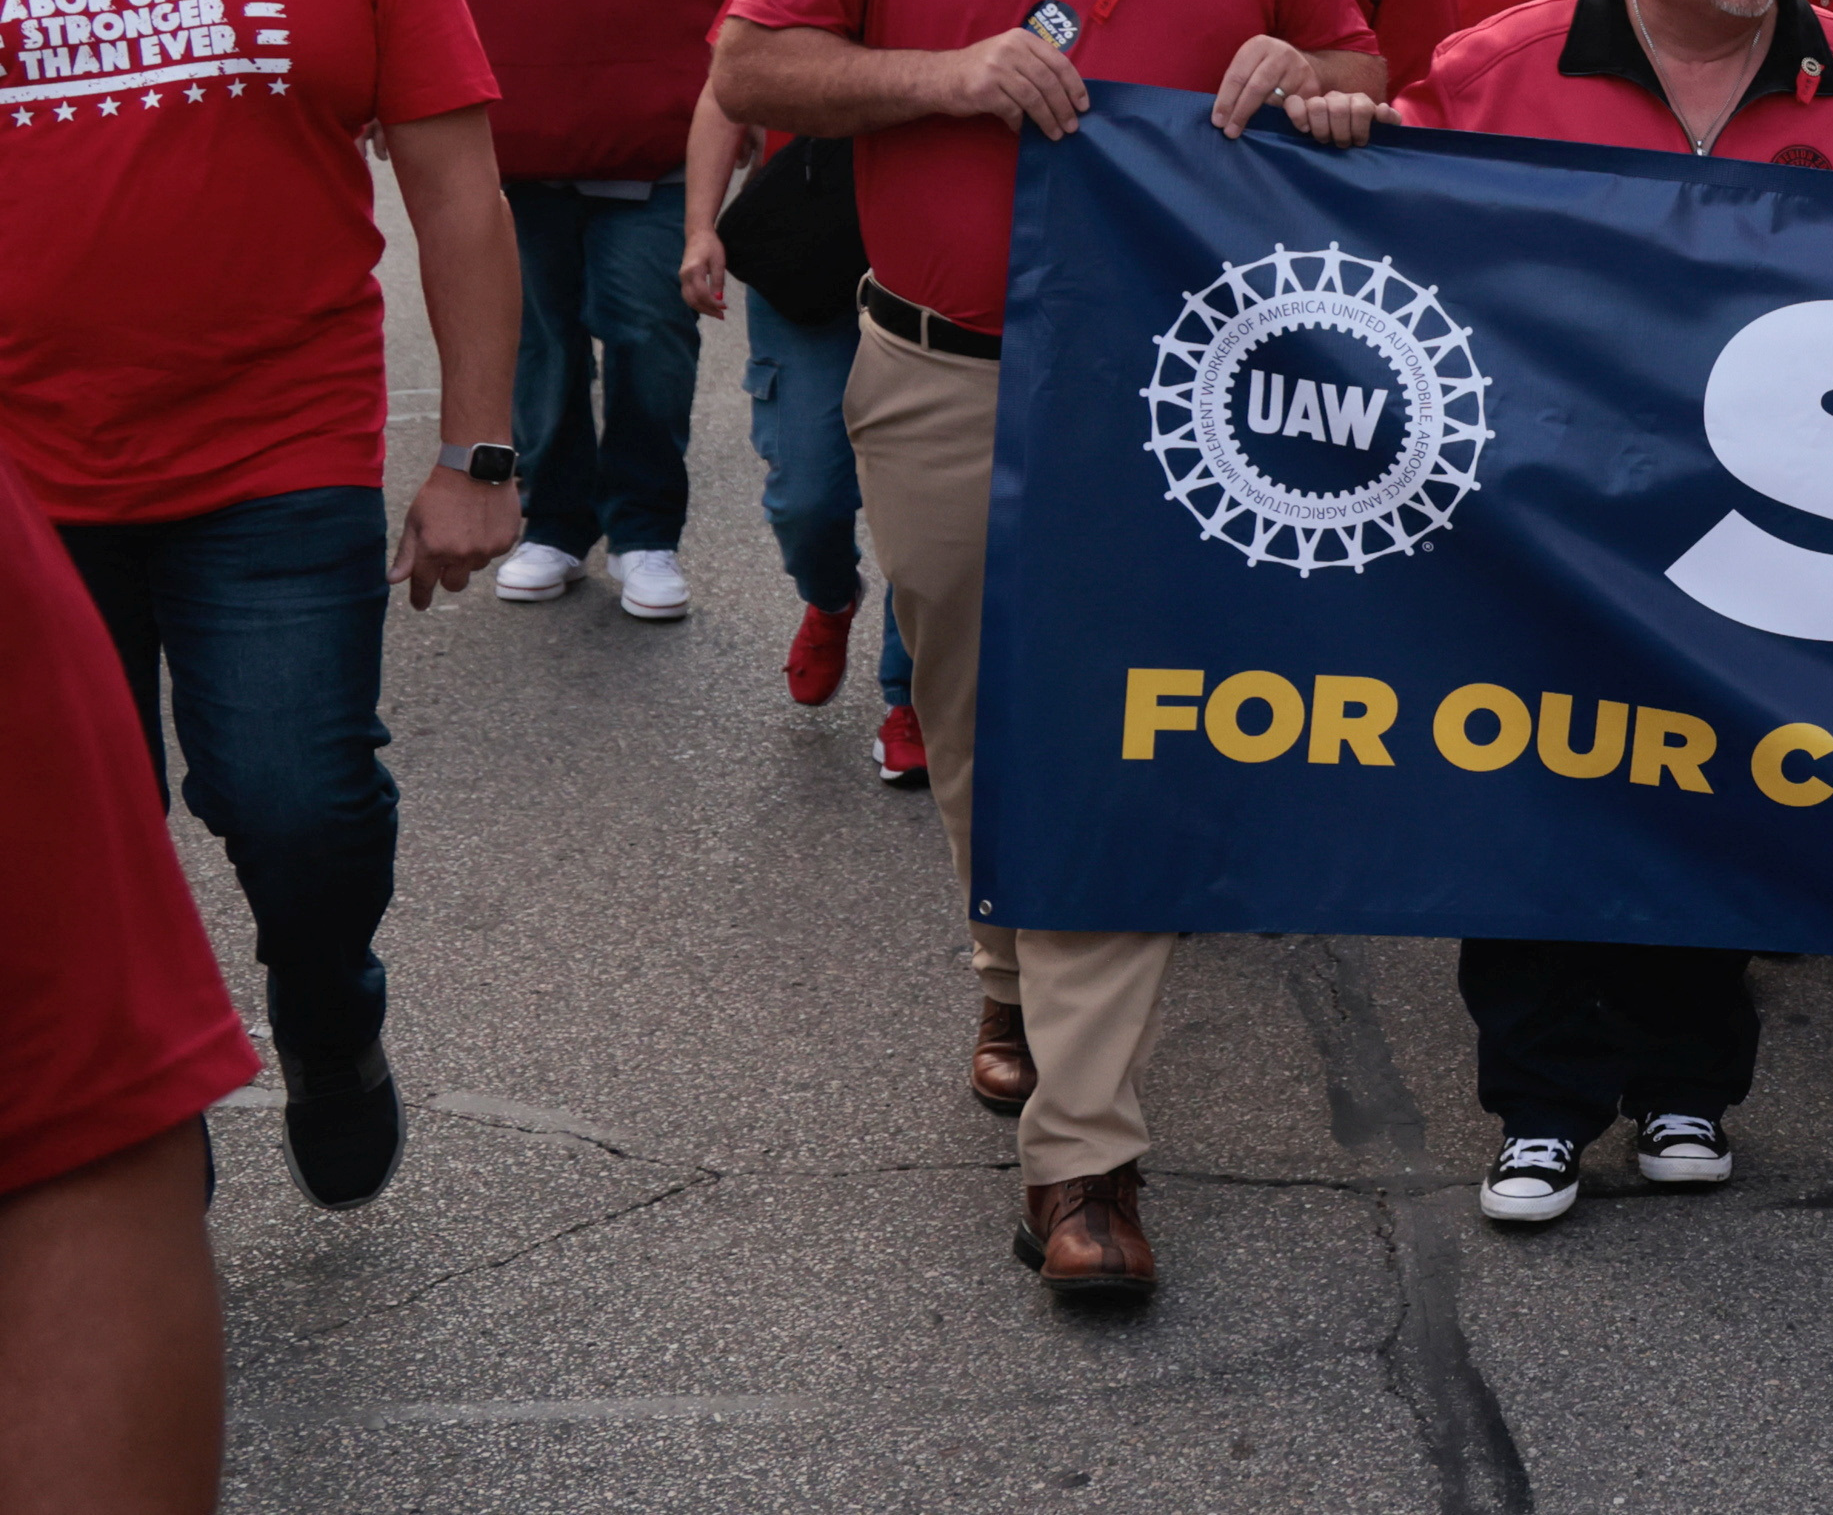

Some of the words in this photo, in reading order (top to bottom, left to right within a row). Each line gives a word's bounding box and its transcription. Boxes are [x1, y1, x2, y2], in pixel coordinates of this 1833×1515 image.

[1034, 11, 1058, 35] READY
[1055, 32, 1067, 44] TO
[1042, 3, 1078, 39] 97%
[19, 41, 130, 80] THAN
[140, 25, 240, 66] EVER
[1237, 318, 1256, 336] OF
[1258, 300, 1326, 325] AMERICA
[1331, 303, 1386, 334] UNITED
[1200, 334, 1240, 396] WORKERS
[1386, 331, 1433, 426] AUTOMOBILE,
[1248, 369, 1388, 451] UAW
[1200, 399, 1241, 483] IMPLEMENT
[1384, 431, 1431, 502] AEROSPACE
[1238, 486, 1347, 520] AGRICULTURAL
[1352, 493, 1383, 514] AND
[1122, 668, 1398, 767] FOR
[1432, 682, 1717, 794] OUR
